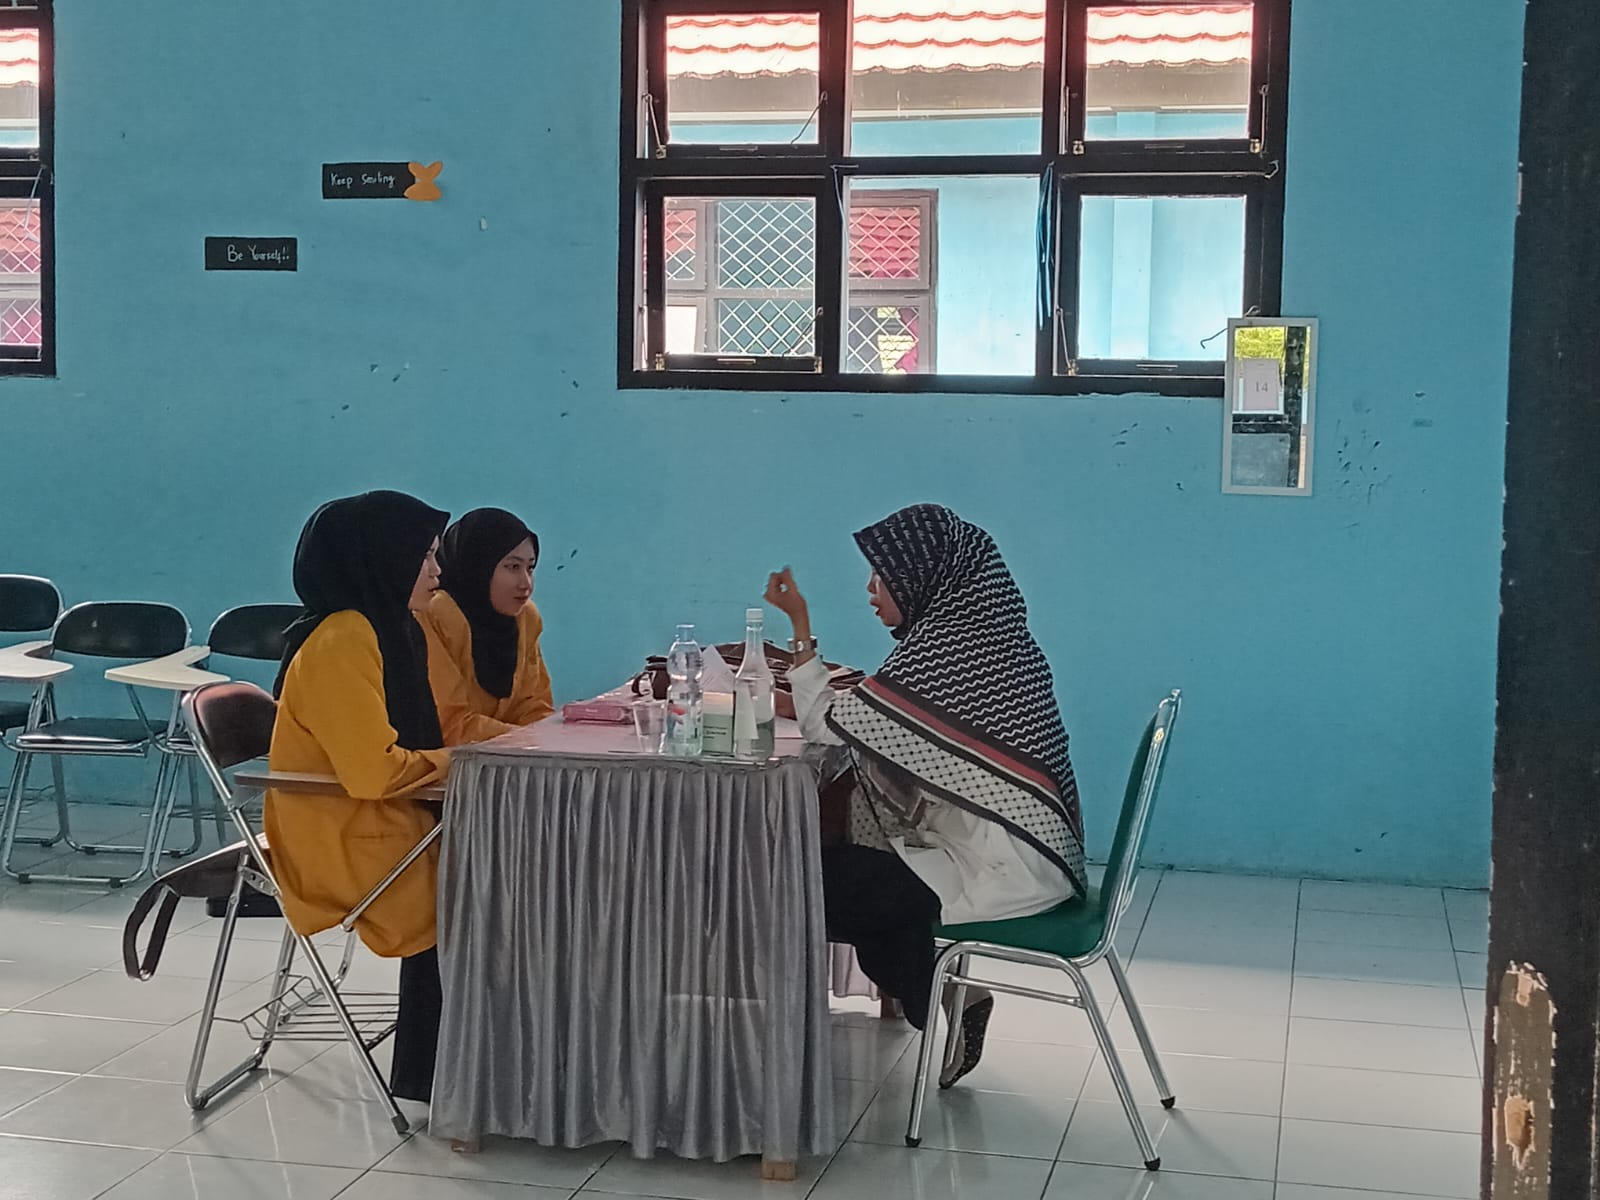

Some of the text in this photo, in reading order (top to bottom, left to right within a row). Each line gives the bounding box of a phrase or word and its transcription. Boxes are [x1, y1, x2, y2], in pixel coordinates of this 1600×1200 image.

[330, 172, 353, 189] Keep
[227, 244, 243, 262] Be
[1255, 381, 1269, 393] 14
